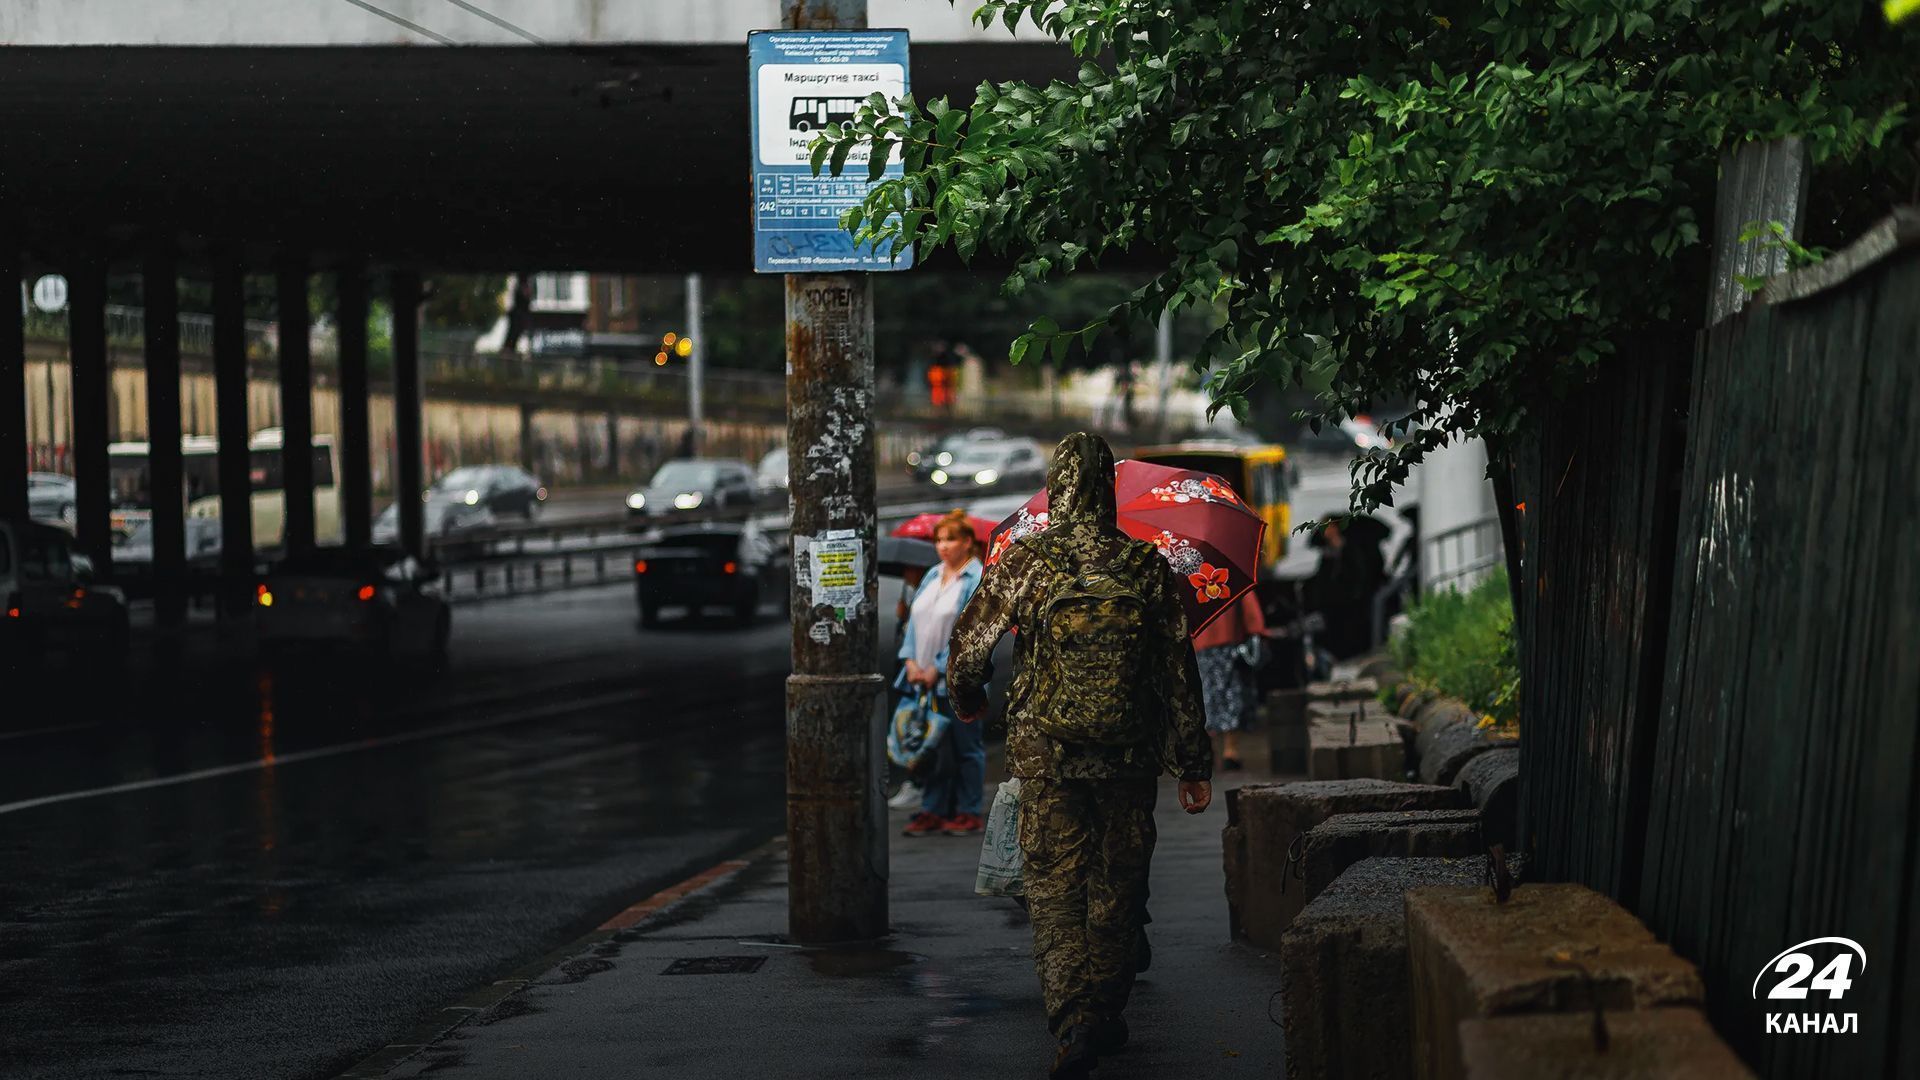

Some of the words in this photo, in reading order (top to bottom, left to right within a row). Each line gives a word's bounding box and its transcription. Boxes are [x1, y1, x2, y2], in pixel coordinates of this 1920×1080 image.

[784, 72, 849, 84] Маршрутне
[852, 72, 879, 82] таксі
[759, 201, 776, 212] 242
